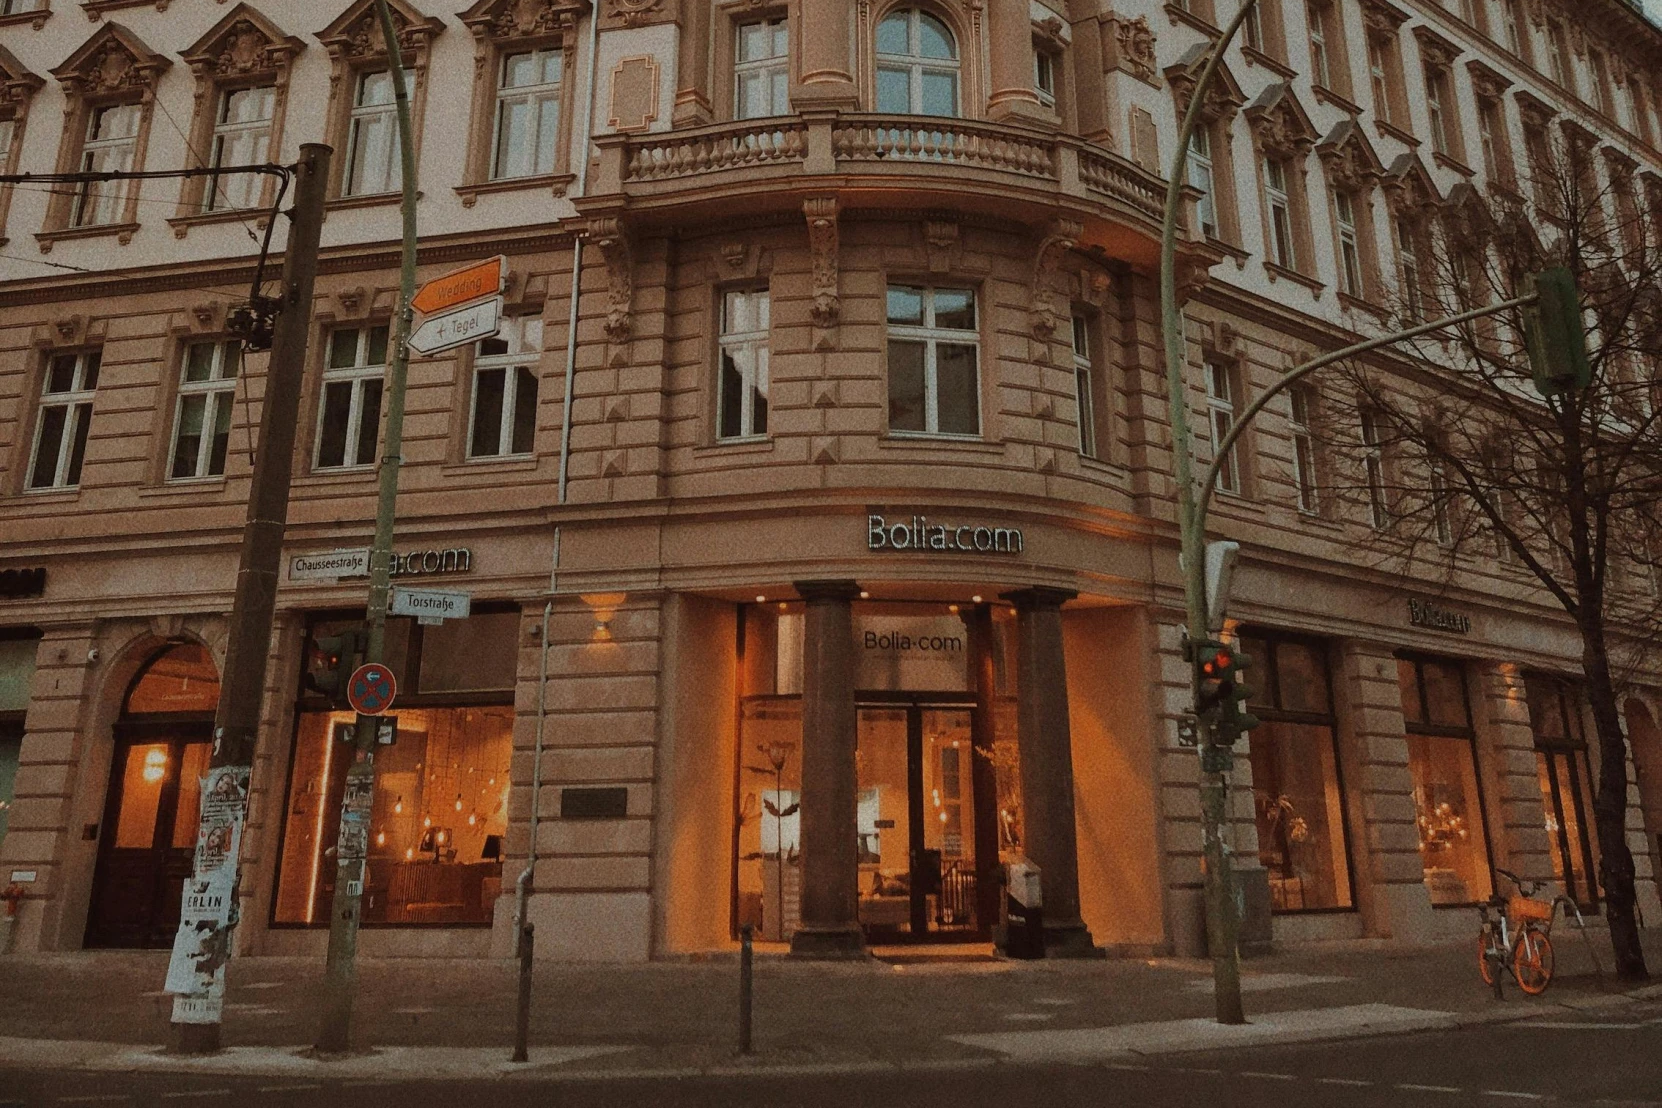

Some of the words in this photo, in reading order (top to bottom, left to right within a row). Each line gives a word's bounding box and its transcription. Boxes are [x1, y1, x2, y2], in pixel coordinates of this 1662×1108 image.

[437, 278, 482, 301] Wedding
[452, 313, 479, 335] Tegel
[868, 515, 1024, 552] Bolia.com
[295, 555, 363, 572] Chausseestraße
[408, 594, 454, 611] Torstraße
